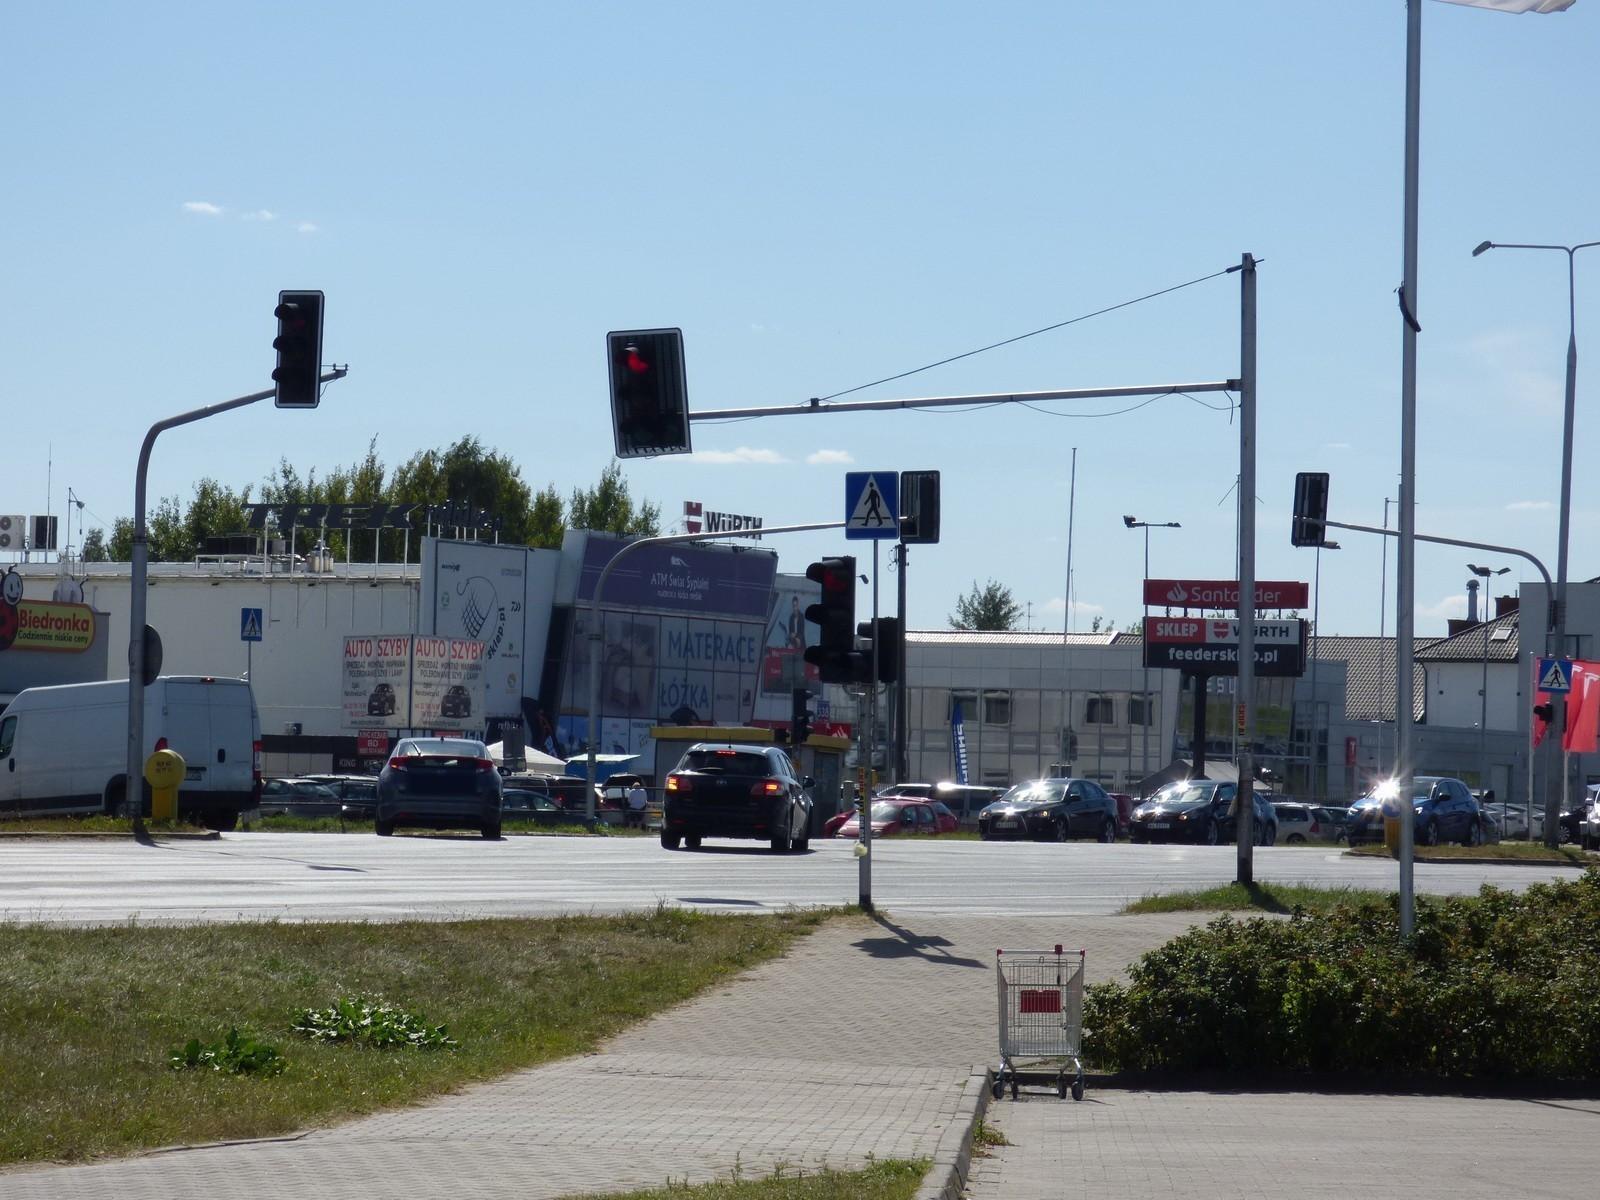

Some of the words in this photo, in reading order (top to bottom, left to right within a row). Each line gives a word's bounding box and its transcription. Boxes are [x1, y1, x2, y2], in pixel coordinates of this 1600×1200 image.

[650, 572, 668, 586] ATM
[1191, 586, 1281, 603] Santader
[19, 609, 90, 632] Biedronka
[18, 630, 53, 641] Codziennie
[54, 631, 73, 642] niskie
[1156, 622, 1199, 637] SKLEP
[1233, 625, 1289, 638] WRTH
[344, 639, 373, 657] AUTO
[377, 637, 409, 657] SZYBY
[415, 638, 446, 657] AUTO
[451, 640, 485, 660] SZYBY
[668, 630, 756, 664] MATERACE
[1168, 647, 1278, 664] feedersklp.pl
[661, 675, 709, 709] ŁÓŻKA
